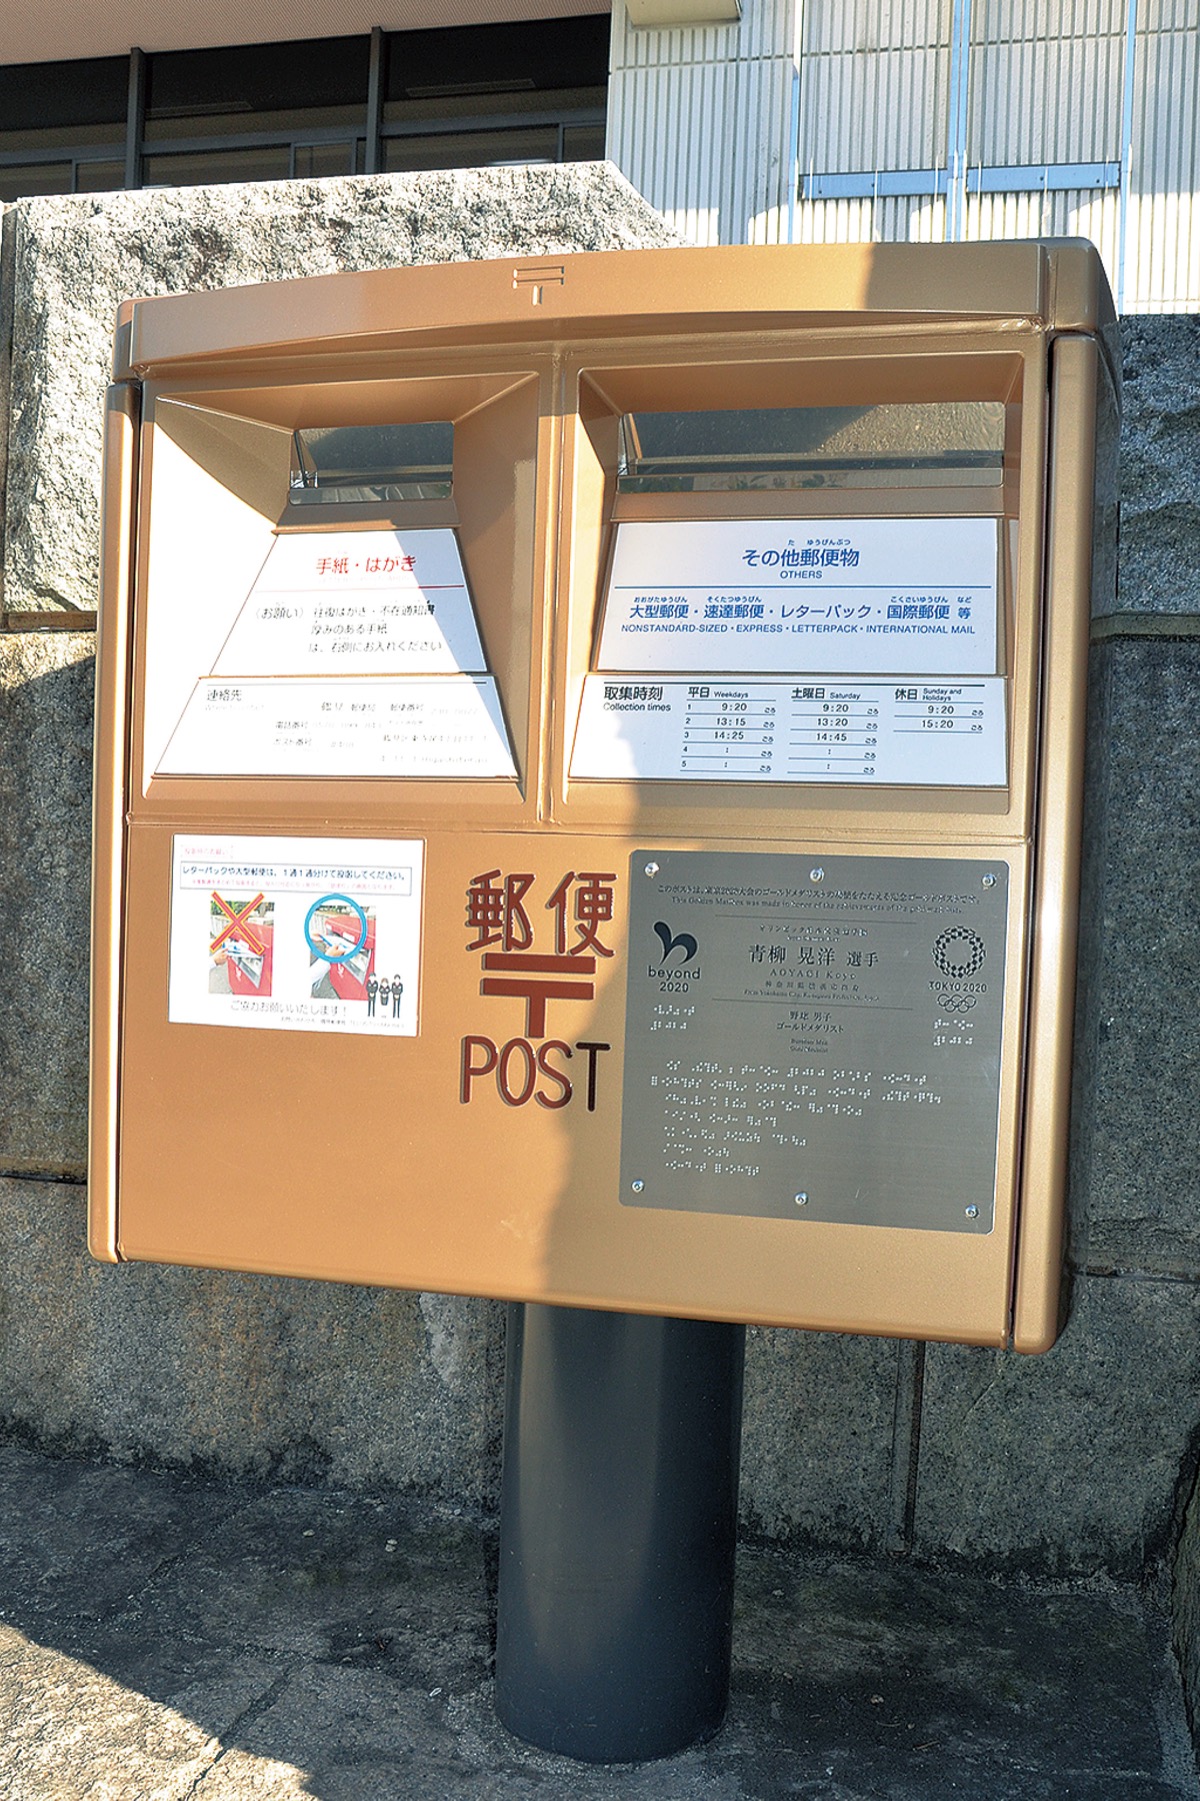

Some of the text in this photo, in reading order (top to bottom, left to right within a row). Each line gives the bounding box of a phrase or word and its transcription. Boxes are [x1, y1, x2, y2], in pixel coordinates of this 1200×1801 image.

[742, 549, 860, 567] その他郵便物
[316, 556, 416, 575] 手紙・はがき
[780, 570, 823, 579] OTHERS
[958, 606, 972, 619] 等
[621, 623, 976, 634] NONSTANDARD-SIZED EXPRESS LETTERPACK INTERNATIONAL MAIL
[604, 686, 664, 701] 取集時刻
[688, 687, 710, 698] 平日
[714, 691, 749, 699] Weekdays
[791, 687, 825, 700] 土曜日
[829, 692, 861, 700] Saturday
[895, 688, 918, 700] 休日
[603, 702, 672, 712] Collection times
[721, 703, 747, 712] 9:20
[822, 704, 849, 713] 9:20
[928, 705, 954, 714] 9:20
[716, 717, 746, 726] 13:15
[817, 718, 849, 727] 13:20
[921, 719, 954, 729] 15:20
[714, 731, 744, 740] 14:25
[816, 732, 847, 742] 14:45
[465, 869, 618, 957] 郵便
[749, 944, 879, 967] 青柳 晃洋 選手
[648, 965, 701, 981] beyond
[770, 968, 857, 981] AOYAGI Koyo
[660, 982, 689, 993] 2020
[929, 981, 987, 993] TOKYO 2020
[460, 1035, 611, 1112] POST
